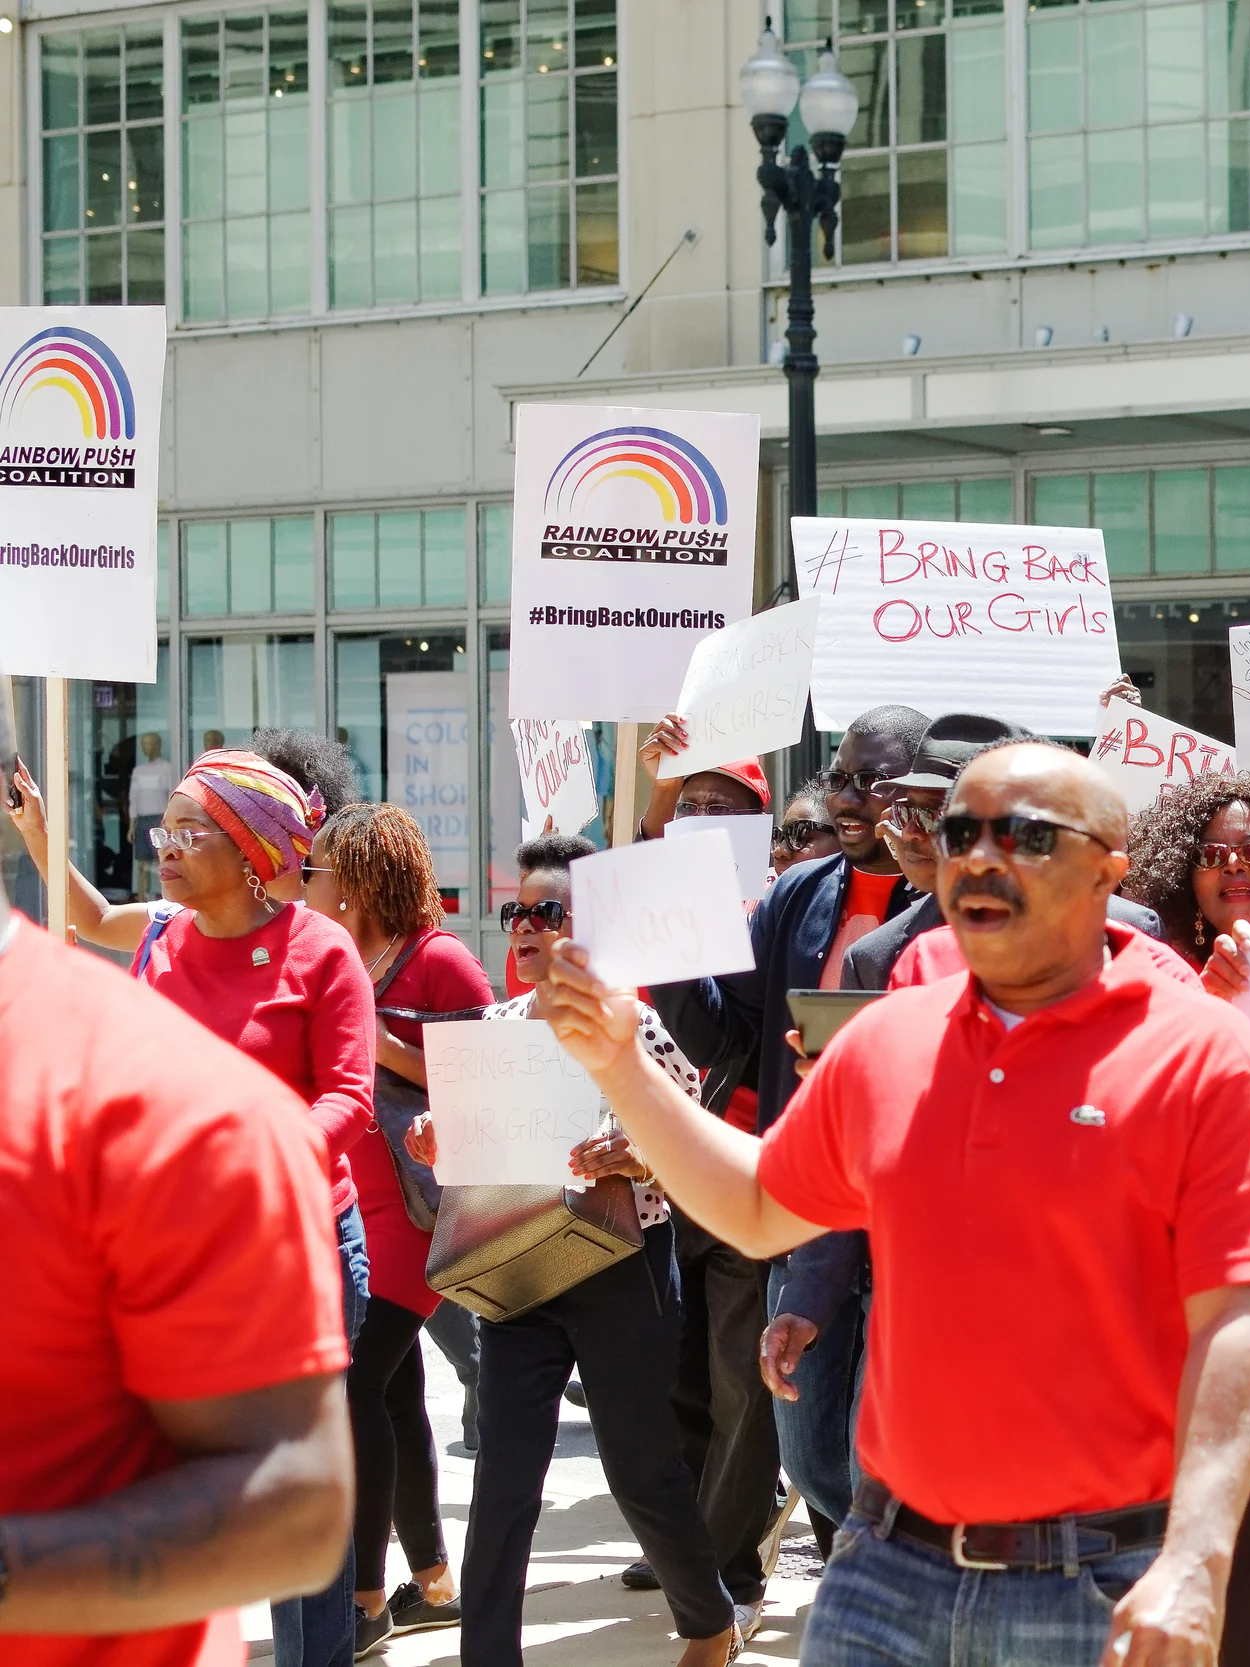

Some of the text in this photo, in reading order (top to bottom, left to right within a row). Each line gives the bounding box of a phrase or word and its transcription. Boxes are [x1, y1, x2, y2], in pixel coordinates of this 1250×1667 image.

[0, 446, 79, 465] AINBOW
[543, 525, 659, 544] RAINBOW
[0, 543, 135, 569] ringBackOurGirls
[551, 546, 714, 563] COALITION
[878, 529, 1009, 585] BRING
[529, 606, 726, 629] #BringBackOurGirls
[873, 598, 983, 643] OUR
